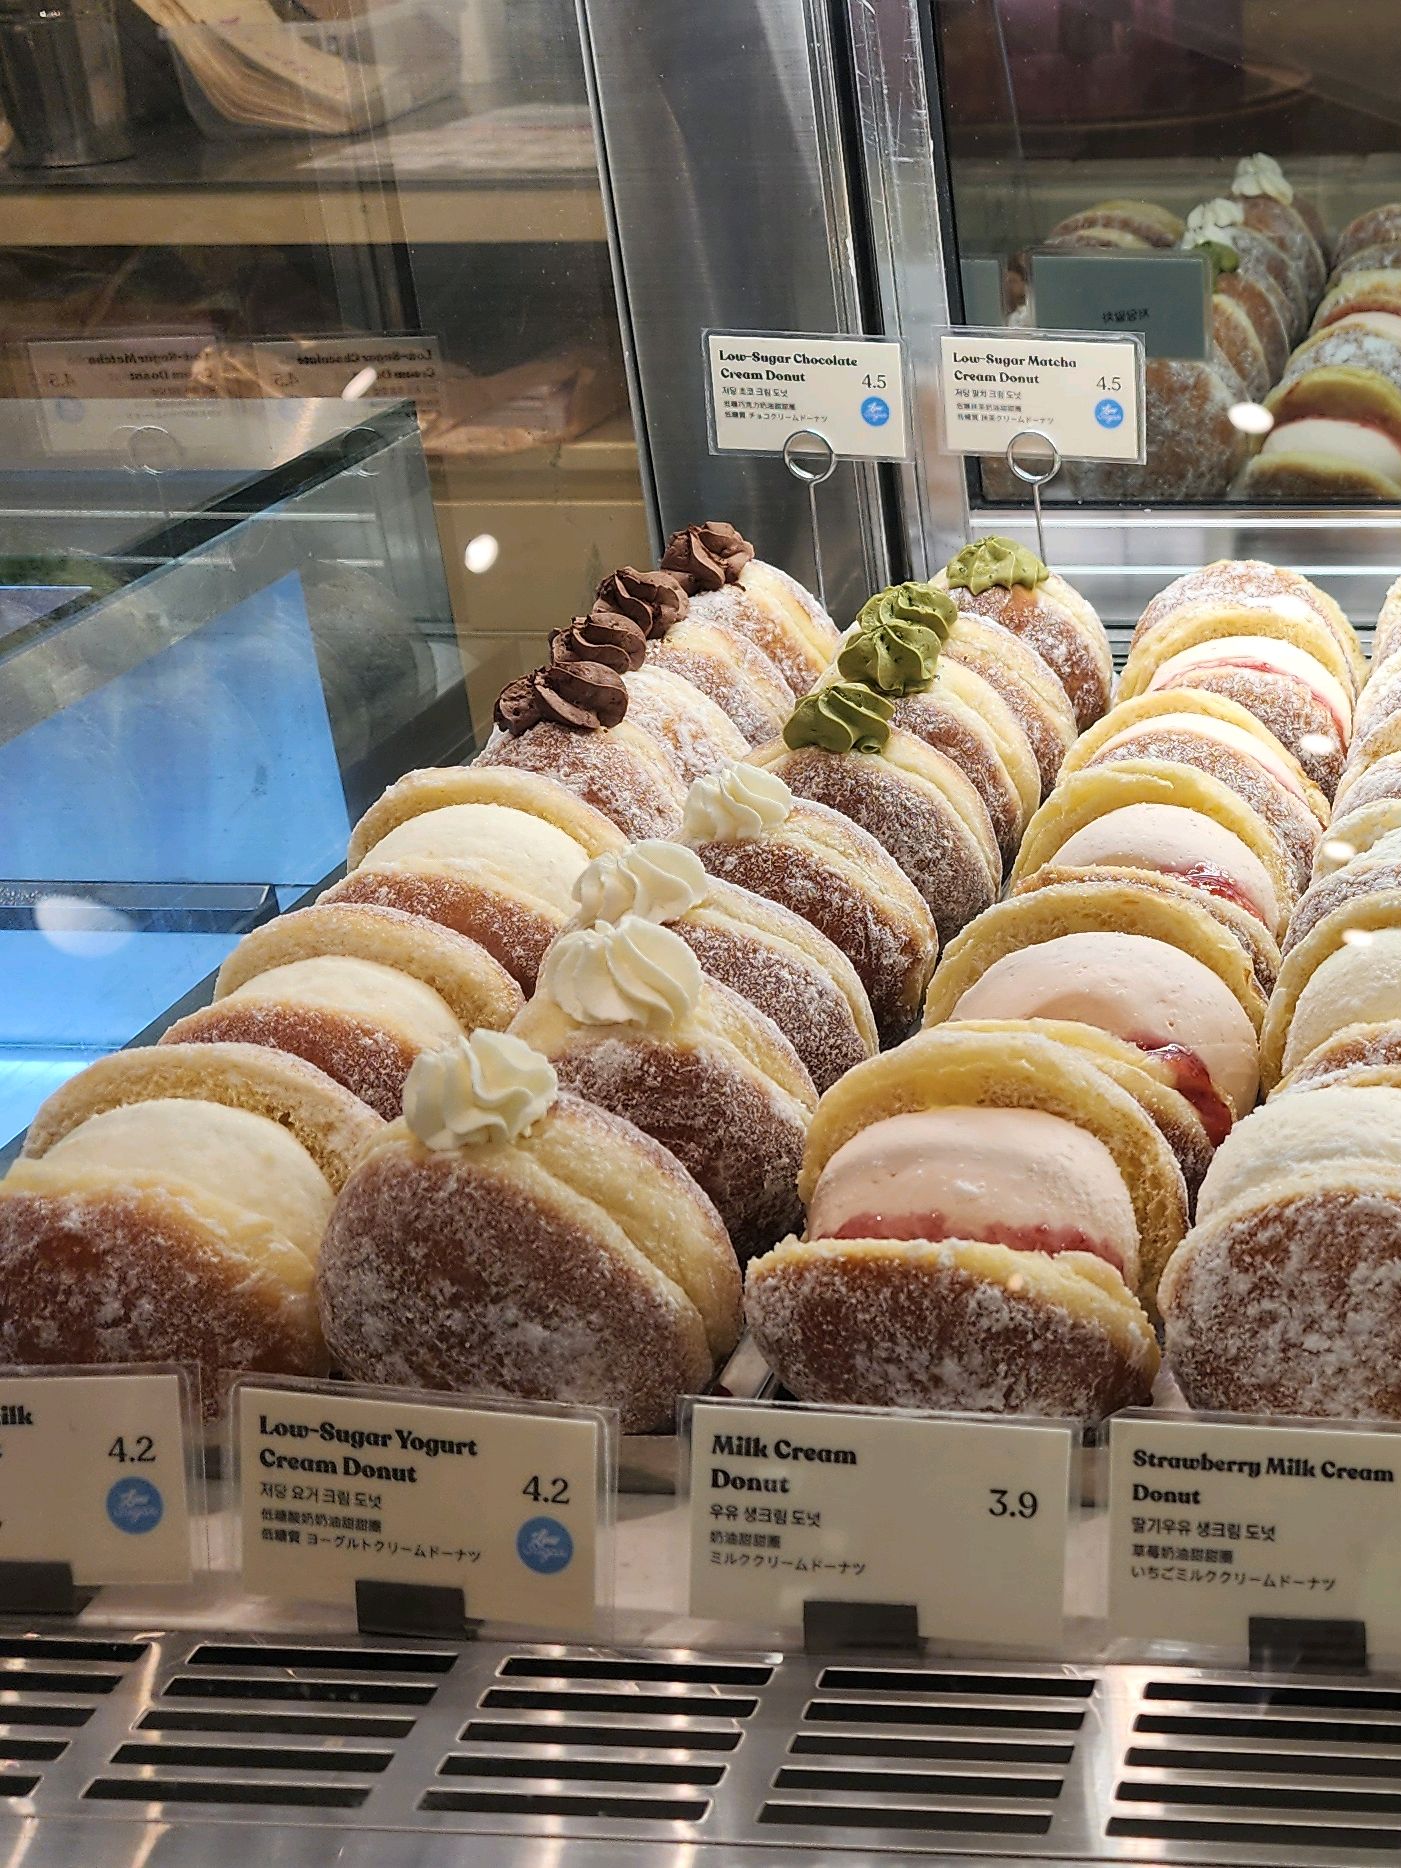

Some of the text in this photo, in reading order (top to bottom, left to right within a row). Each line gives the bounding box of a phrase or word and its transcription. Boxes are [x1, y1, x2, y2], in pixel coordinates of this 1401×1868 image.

[719, 350, 858, 367] Low-Sugar Chocolate
[953, 352, 1077, 369] Low-Sugar Matcha
[720, 368, 806, 382] Cream Donut
[861, 374, 887, 390] 4.5
[954, 370, 1040, 384] Cream Donut
[1096, 376, 1122, 392] 4.5
[0, 1405, 33, 1426] ilk
[259, 1415, 478, 1457] Low-Sugar Yogurt
[108, 1436, 157, 1463] 4.2
[712, 1434, 858, 1465] Milk Cream
[259, 1449, 418, 1484] Cream Donut
[1133, 1449, 1394, 1483] Strawberry Milk Cream
[522, 1475, 571, 1505] 4.2
[710, 1469, 791, 1494] Donut
[1132, 1484, 1201, 1505] Donut
[260, 1481, 383, 1510] 저당 요거 크림 도넛
[988, 1488, 1038, 1519] 3.9
[710, 1503, 822, 1529] 우유 생크림 도넛
[1131, 1516, 1276, 1543] 딸기우유 생크림 도넛
[710, 1551, 867, 1576] ミルククリームドーナツ
[1130, 1565, 1337, 1592] いちごミルククリームドーナツ
